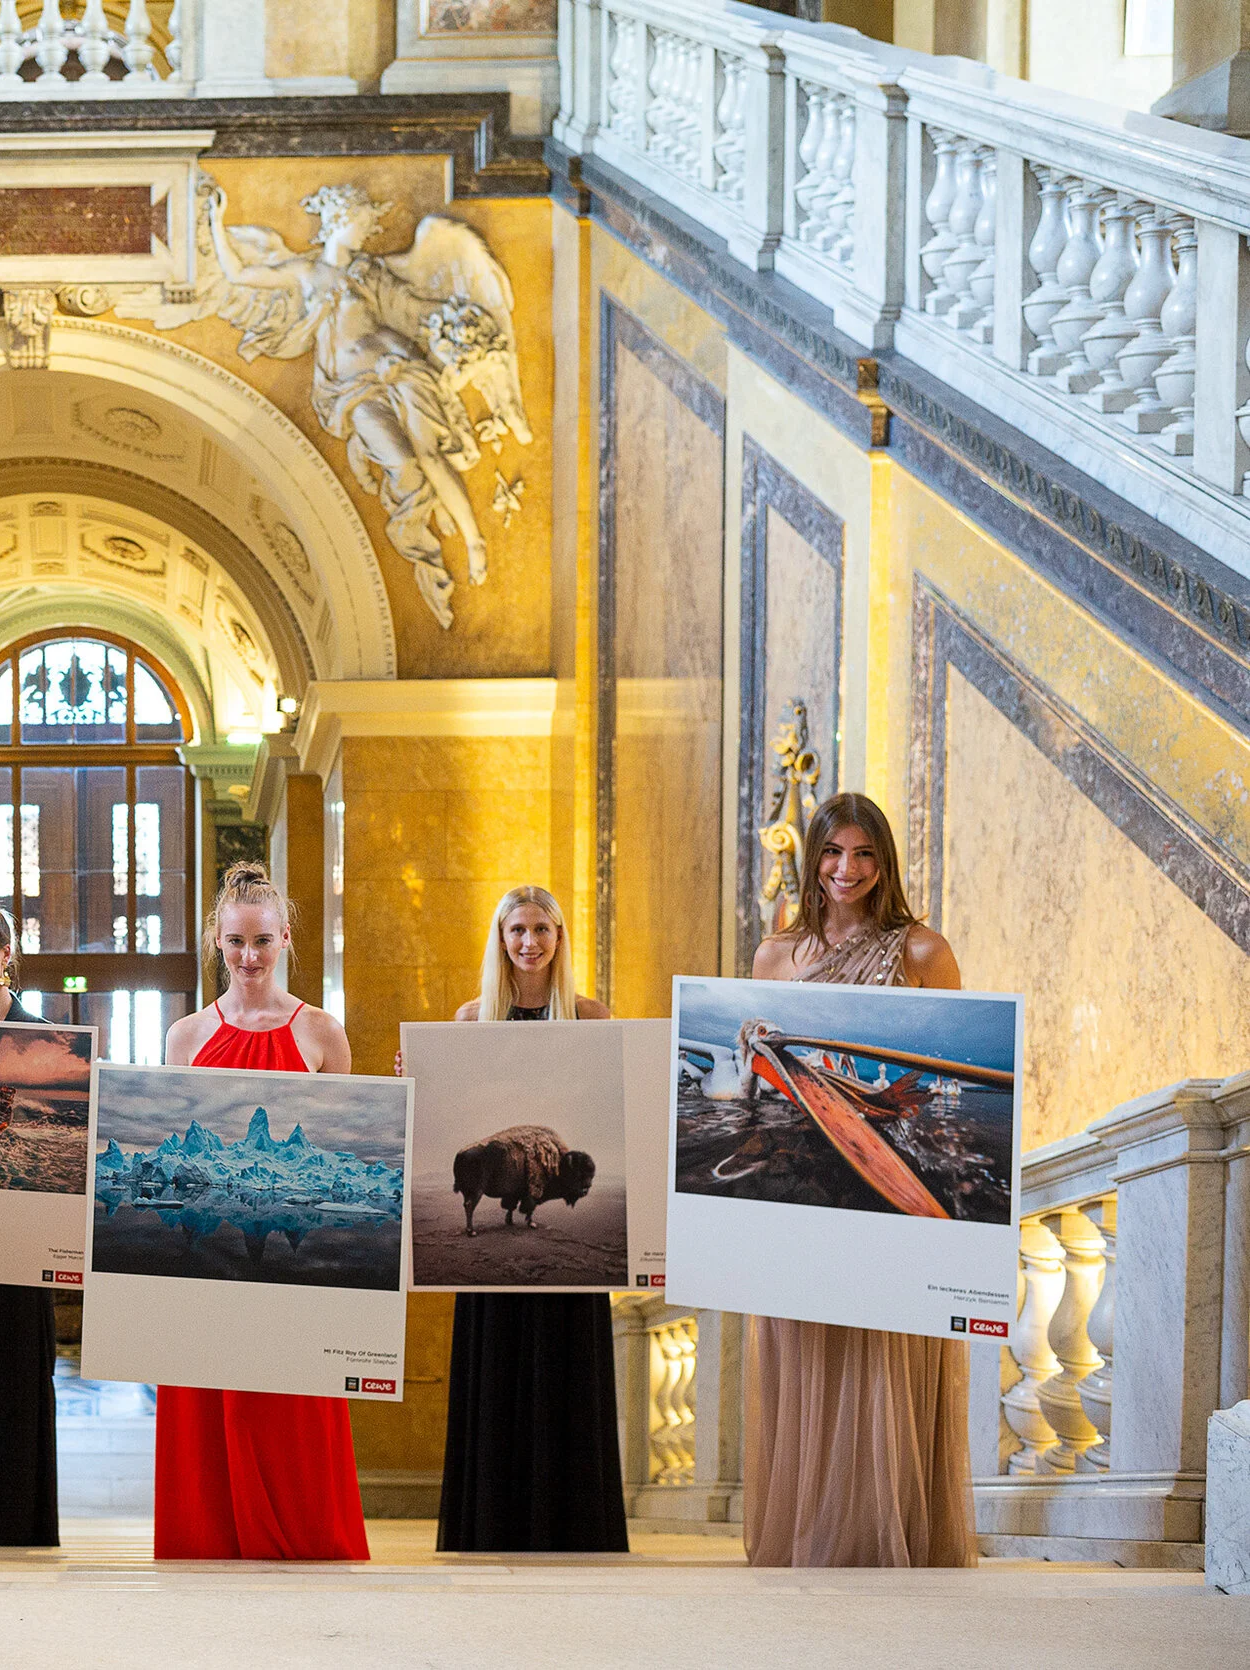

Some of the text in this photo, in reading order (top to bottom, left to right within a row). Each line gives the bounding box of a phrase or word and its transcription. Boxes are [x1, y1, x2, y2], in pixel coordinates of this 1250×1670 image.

[58, 1274, 80, 1282] cewe
[939, 1286, 967, 1294] leckeres
[968, 1288, 1010, 1298] Abendessen
[973, 1321, 1004, 1334] cewe
[373, 1358, 398, 1366] Stephan
[364, 1381, 393, 1391] cewe
